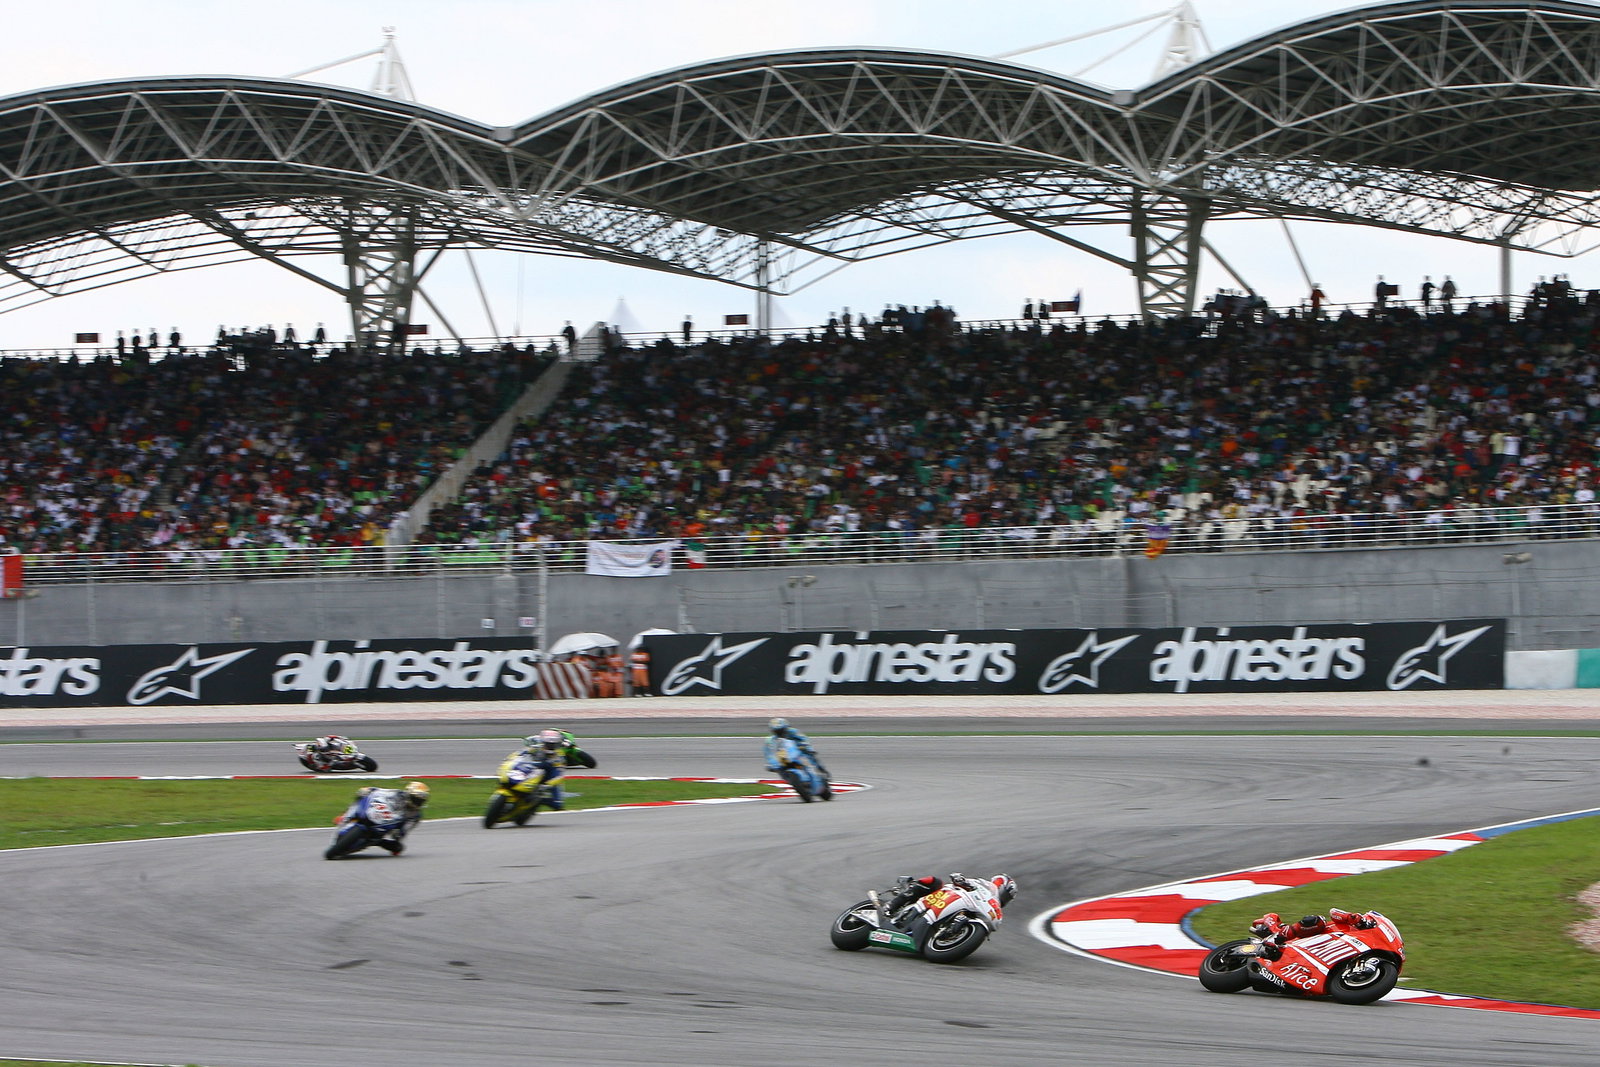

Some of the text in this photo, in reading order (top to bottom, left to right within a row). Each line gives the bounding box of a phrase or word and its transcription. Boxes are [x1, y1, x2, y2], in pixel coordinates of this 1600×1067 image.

[272, 640, 538, 704] alpinestars
[785, 631, 1016, 694] alpinestars
[1150, 626, 1366, 693] alpinestars
[1259, 967, 1286, 989] SanDisk
[1280, 962, 1318, 990] Alice
